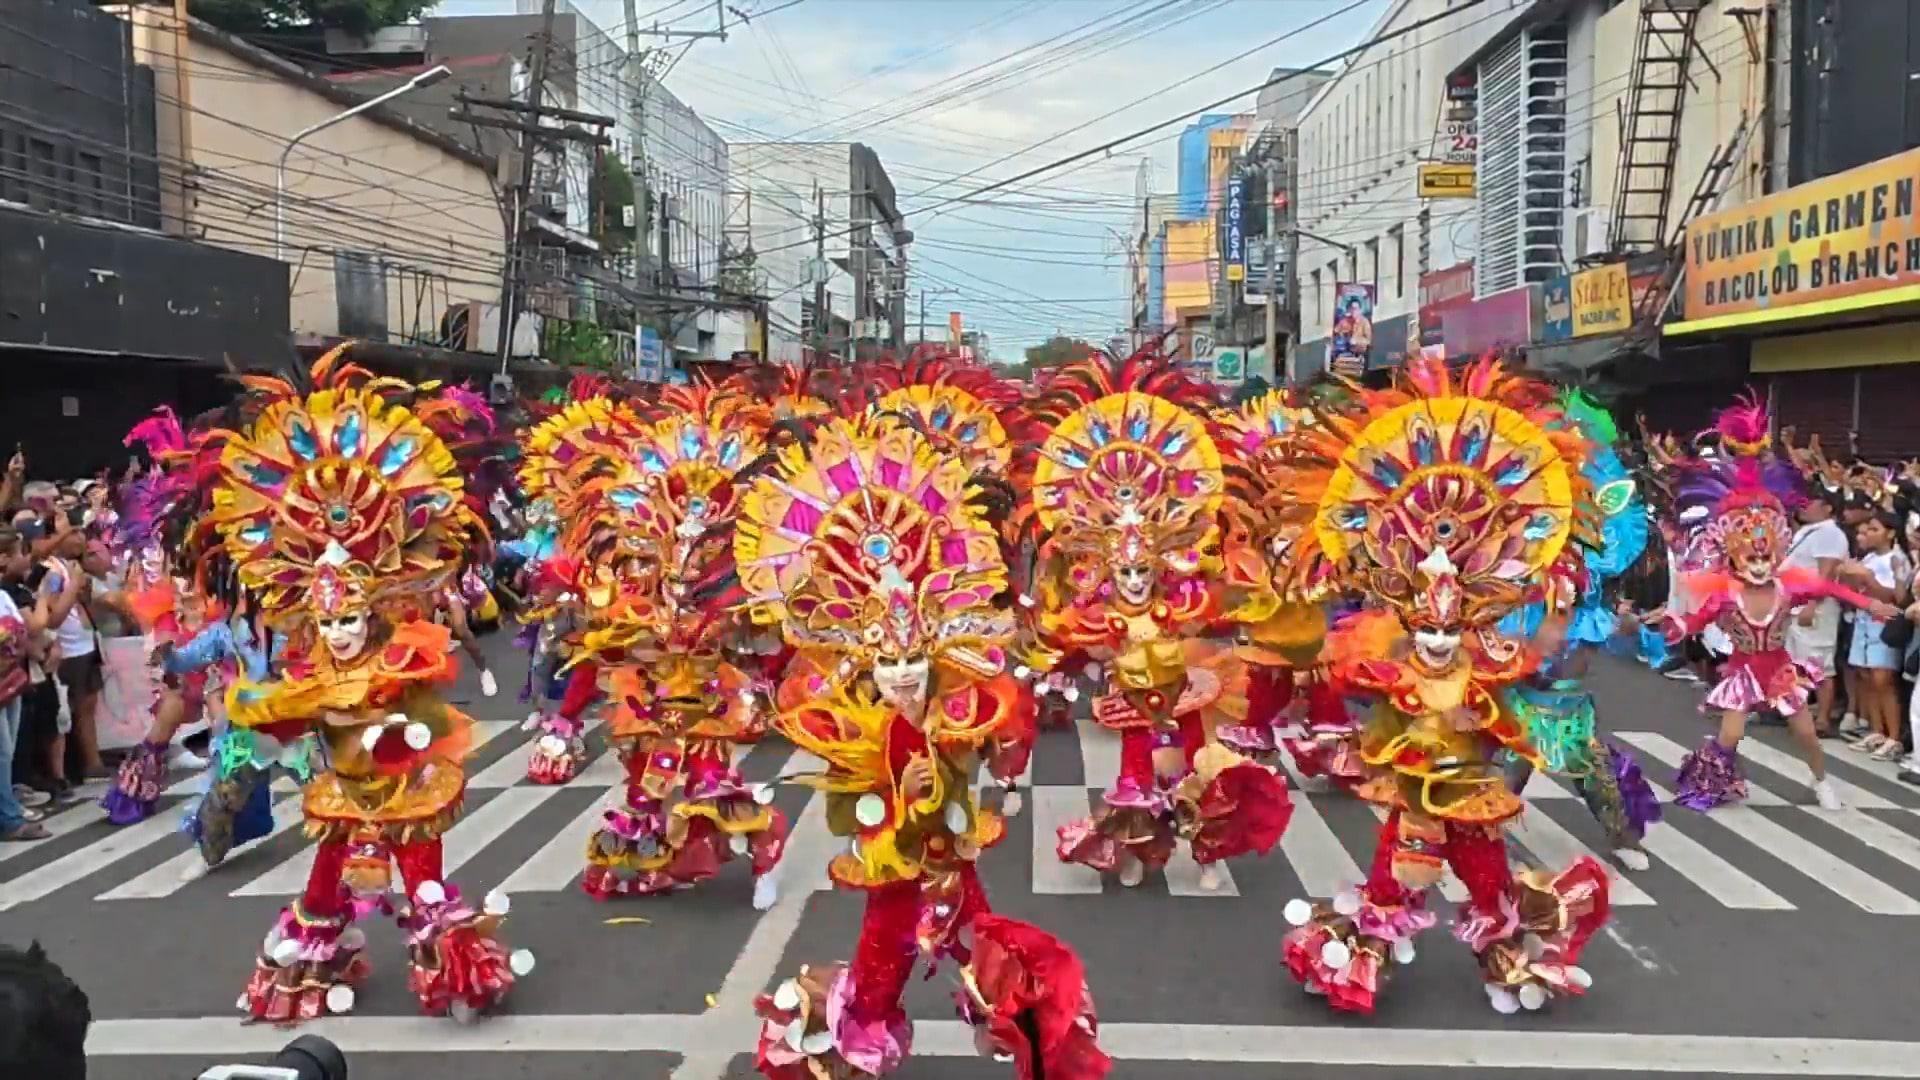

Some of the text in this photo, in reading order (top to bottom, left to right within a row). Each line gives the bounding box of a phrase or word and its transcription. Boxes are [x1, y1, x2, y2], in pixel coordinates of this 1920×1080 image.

[1452, 135, 1478, 151] 24
[1229, 185, 1241, 260] PAG-ASA
[1693, 178, 1913, 265] YUNIKA CARMEN
[1705, 262, 1799, 306] BACOLOD
[1811, 239, 1920, 288] BRANCH
